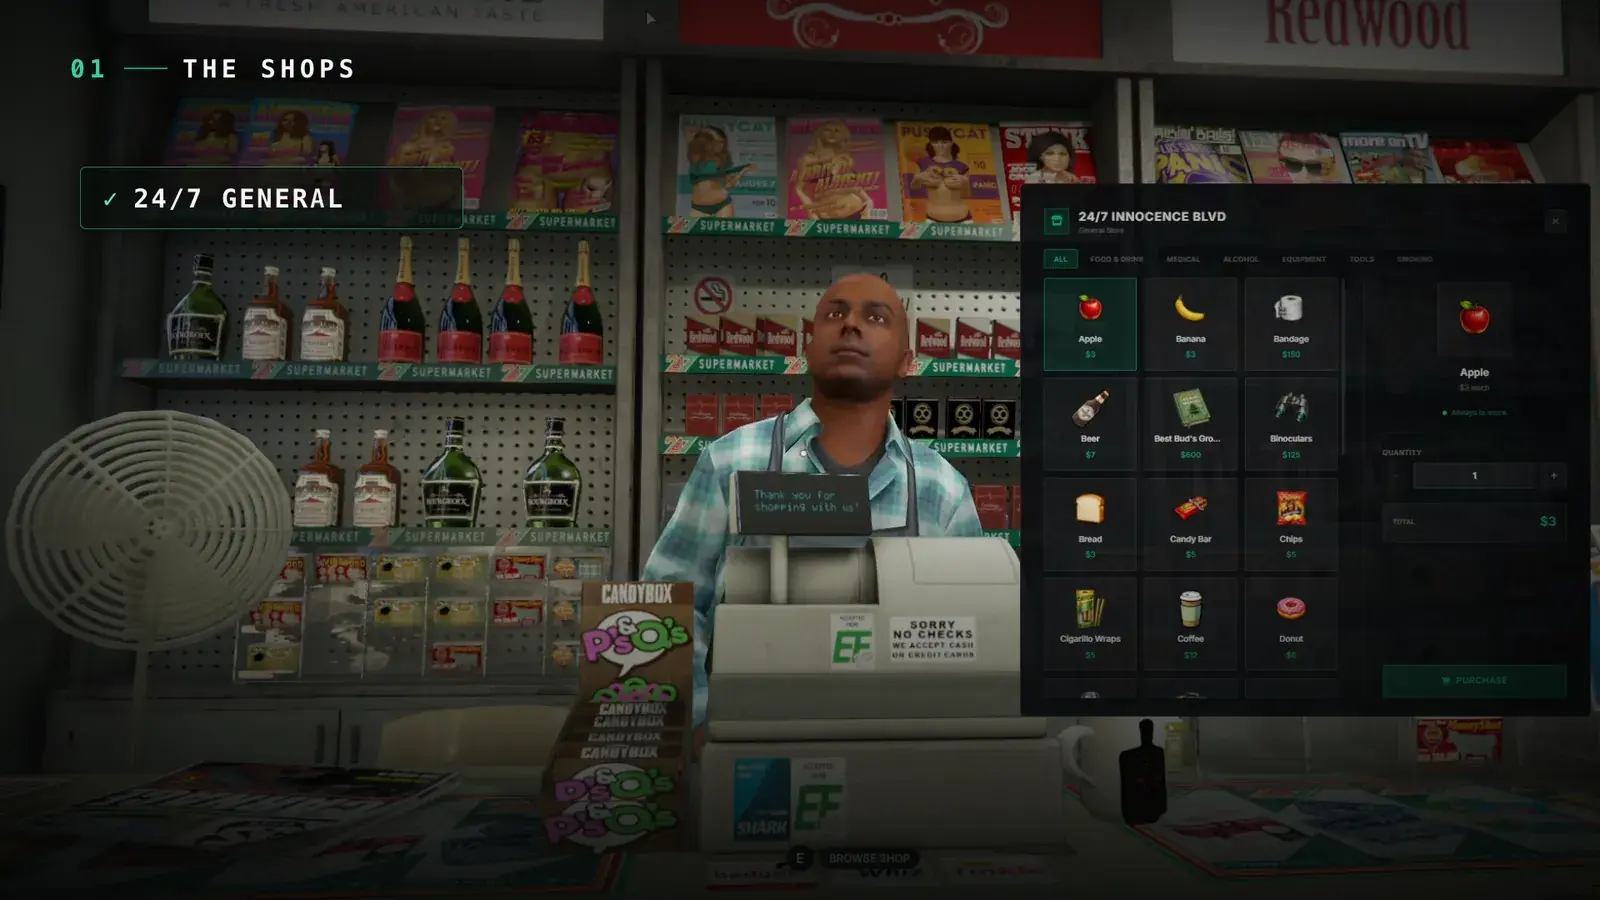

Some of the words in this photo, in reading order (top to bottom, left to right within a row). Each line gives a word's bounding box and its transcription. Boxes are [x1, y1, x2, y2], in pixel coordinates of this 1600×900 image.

[539, 214, 616, 229] SUPERMARKET
[700, 219, 775, 233] SUPERMARKET
[816, 223, 890, 236] SUPERMARKET
[930, 225, 1003, 238] SUPERMARKET
[286, 364, 368, 377] SUPERMARKET
[412, 366, 492, 379] SUPERMARKET
[535, 368, 613, 381] SUPERMARKET
[698, 358, 775, 371] SUPERMARKET
[932, 362, 1006, 374] SUPERMARKET
[933, 442, 1008, 454] SUPERMARKET
[754, 489, 785, 500] Thank
[791, 492, 811, 501] you
[818, 490, 835, 501] for
[754, 501, 805, 513] shopping
[811, 502, 837, 513] with
[404, 531, 486, 543] SUPERMARKET
[529, 531, 611, 544] SUPERMARKET
[602, 584, 673, 604] CANDYBOX
[910, 620, 955, 629] SORRY
[894, 630, 912, 639] NO
[918, 630, 973, 639] CHECKS
[908, 651, 941, 659] CREDIT
[736, 819, 788, 836] SHARK
